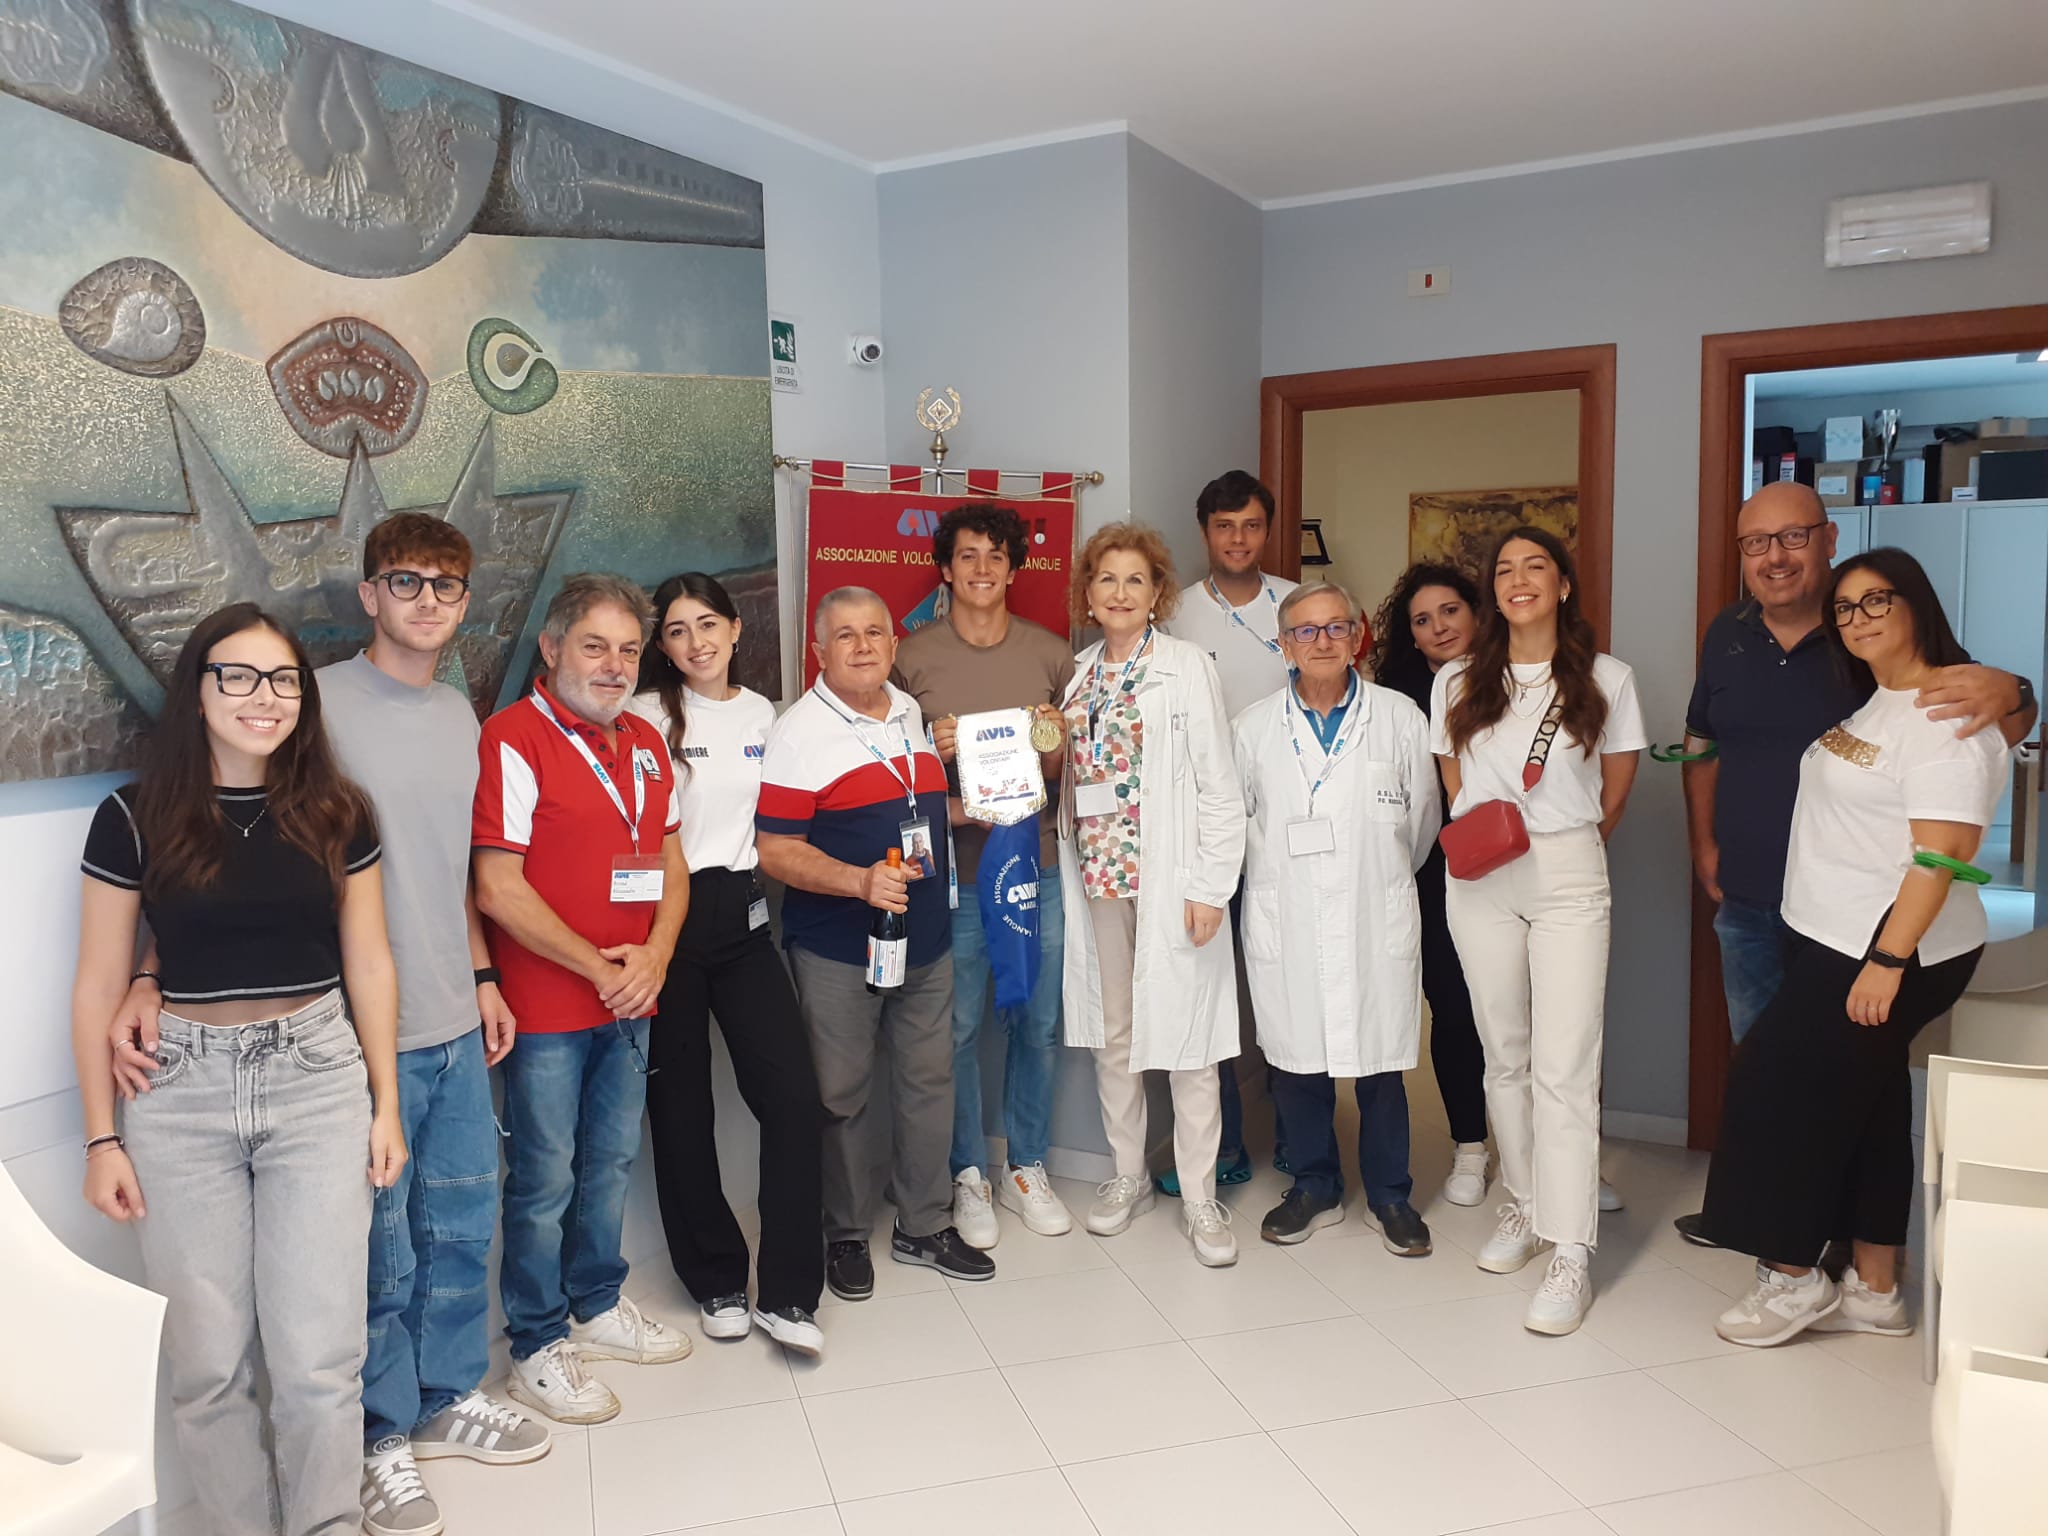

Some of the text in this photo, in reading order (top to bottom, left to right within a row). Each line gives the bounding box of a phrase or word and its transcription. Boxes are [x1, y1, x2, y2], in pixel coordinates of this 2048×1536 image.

[815, 547, 898, 564] ASSOCIAZIONE
[976, 726, 1016, 742] AVIS
[868, 743, 888, 762] AVIS
[592, 762, 610, 785] AVIS
[633, 761, 643, 782] AVIS
[992, 853, 1021, 905] ASSOCIAZIONE
